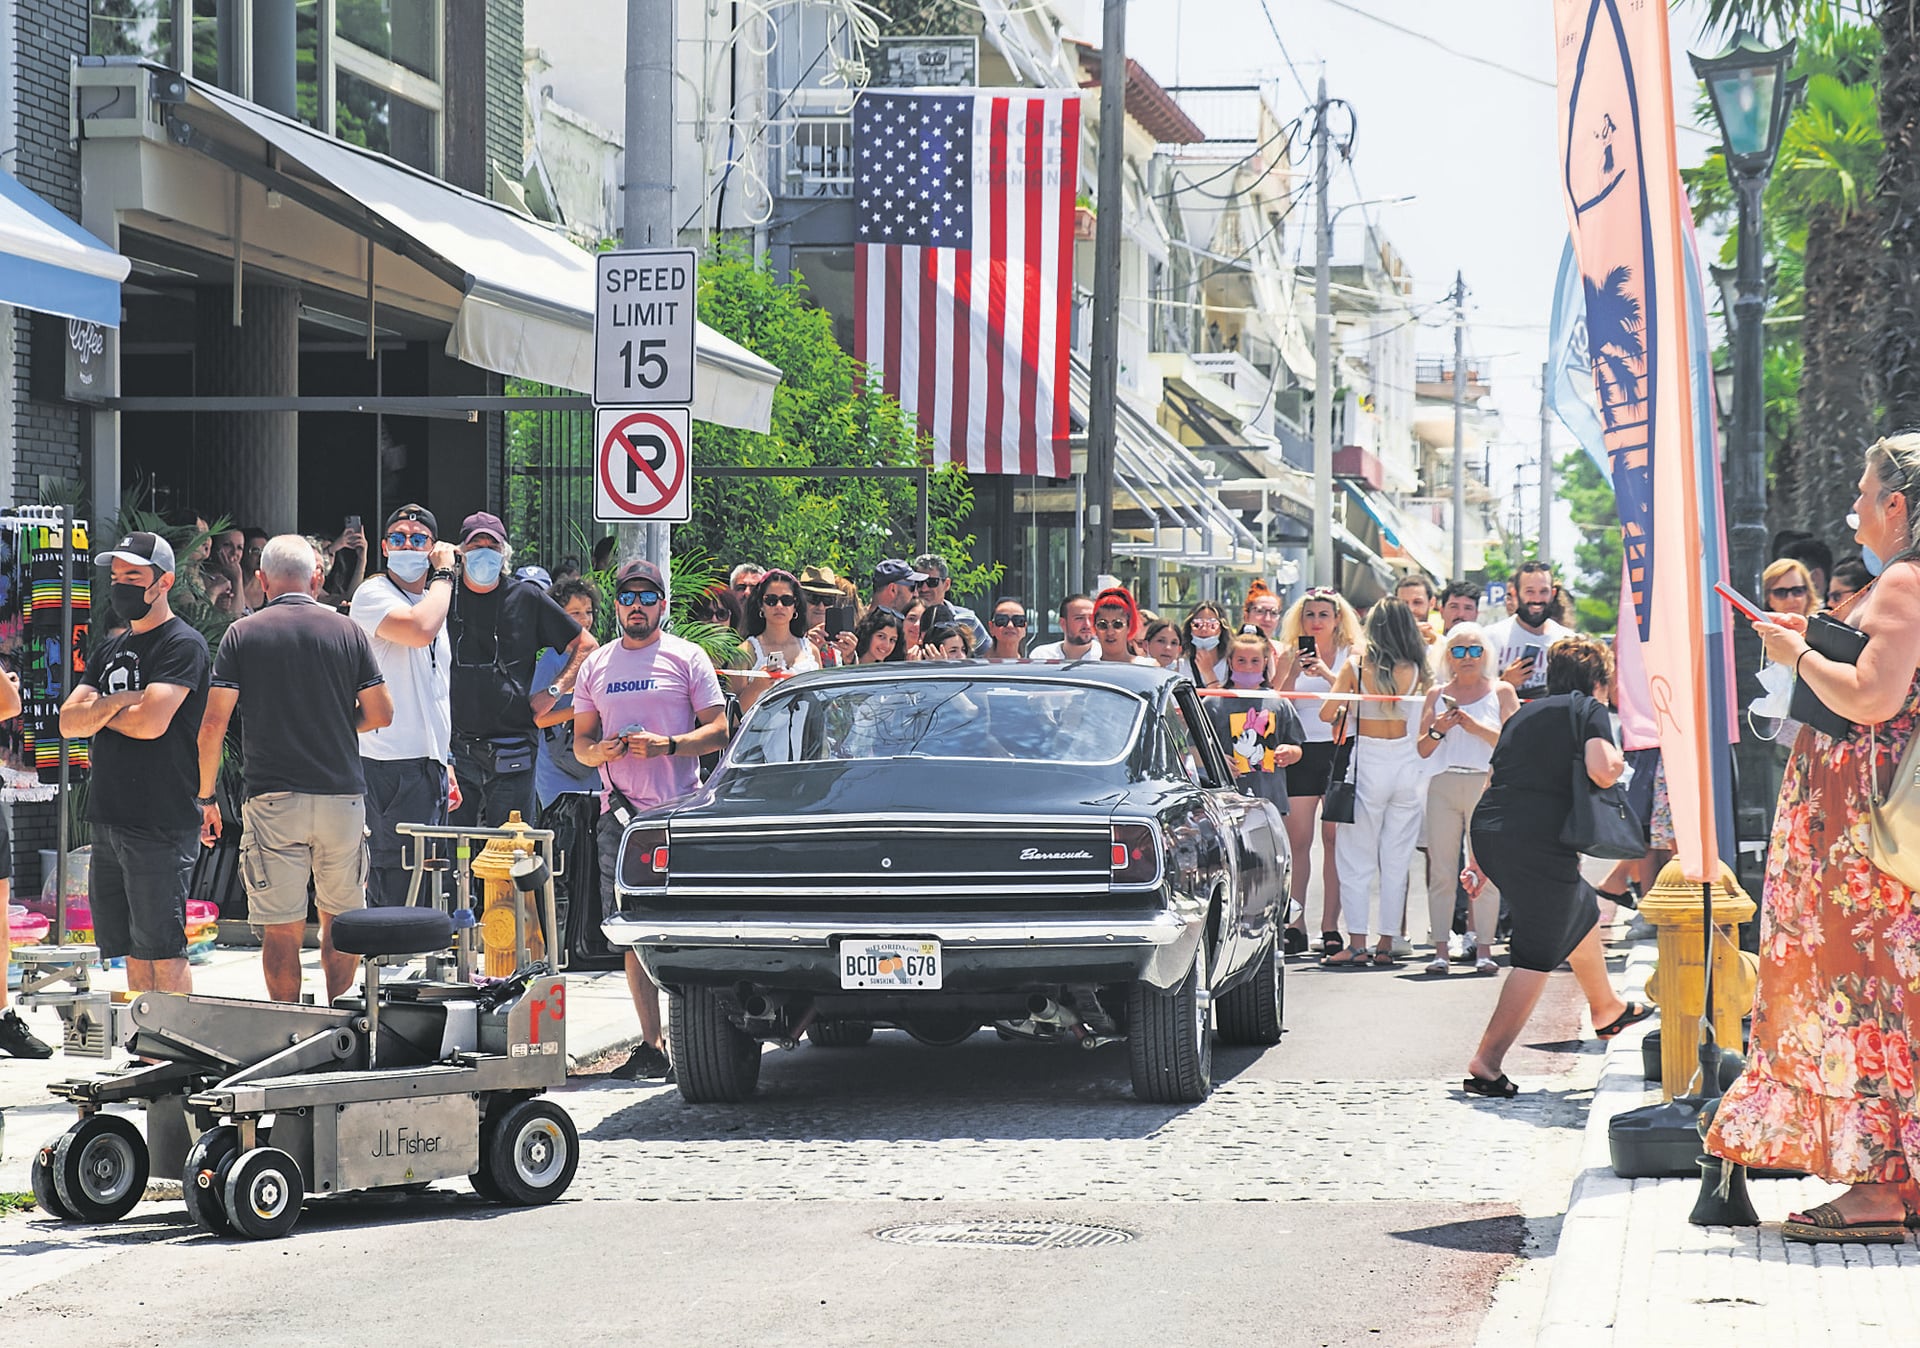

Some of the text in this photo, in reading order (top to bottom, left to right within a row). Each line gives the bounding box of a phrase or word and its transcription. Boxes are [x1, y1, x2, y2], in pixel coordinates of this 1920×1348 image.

[606, 267, 686, 293] SPEED
[613, 302, 678, 327] LIMIT
[619, 339, 669, 389] 15
[627, 434, 667, 494] P
[1019, 847, 1094, 860] Barracuda
[846, 956, 936, 976] BCD 678
